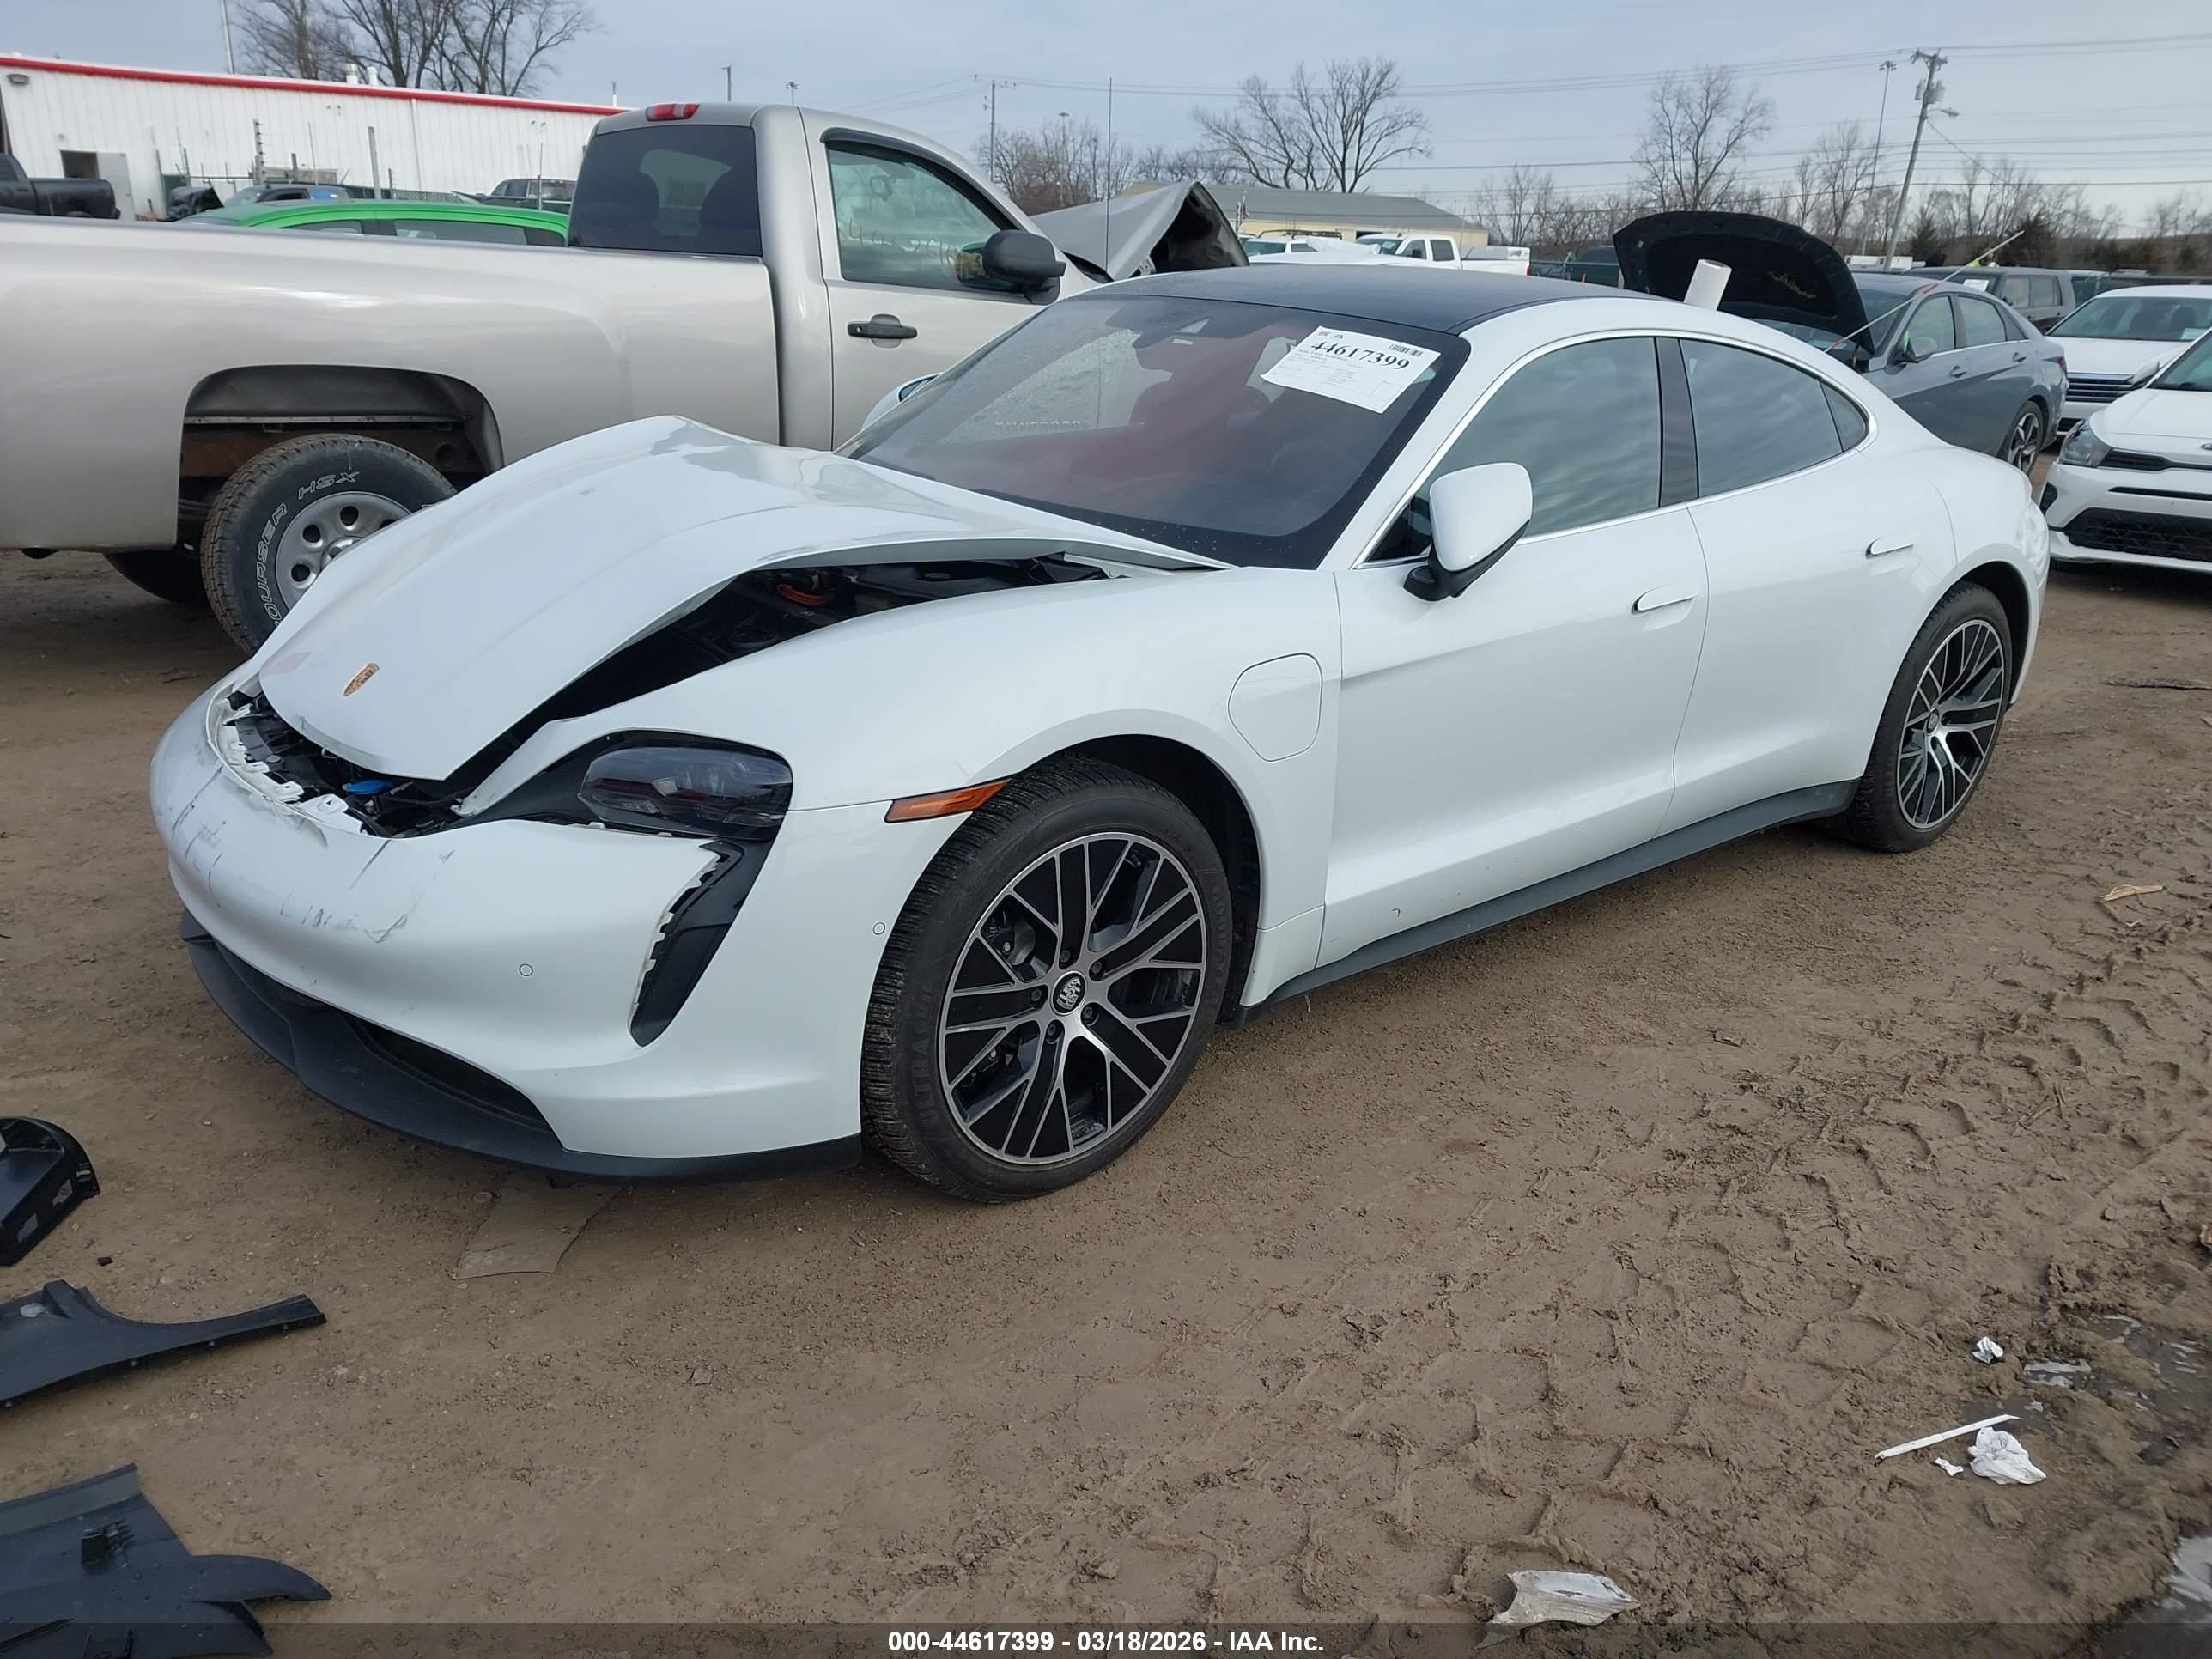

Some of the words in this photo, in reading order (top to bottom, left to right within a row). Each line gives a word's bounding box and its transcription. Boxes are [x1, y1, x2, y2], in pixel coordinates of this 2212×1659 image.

[1310, 341, 1410, 370] 44617399
[256, 502, 288, 627] OURSER
[298, 471, 360, 500] HSX
